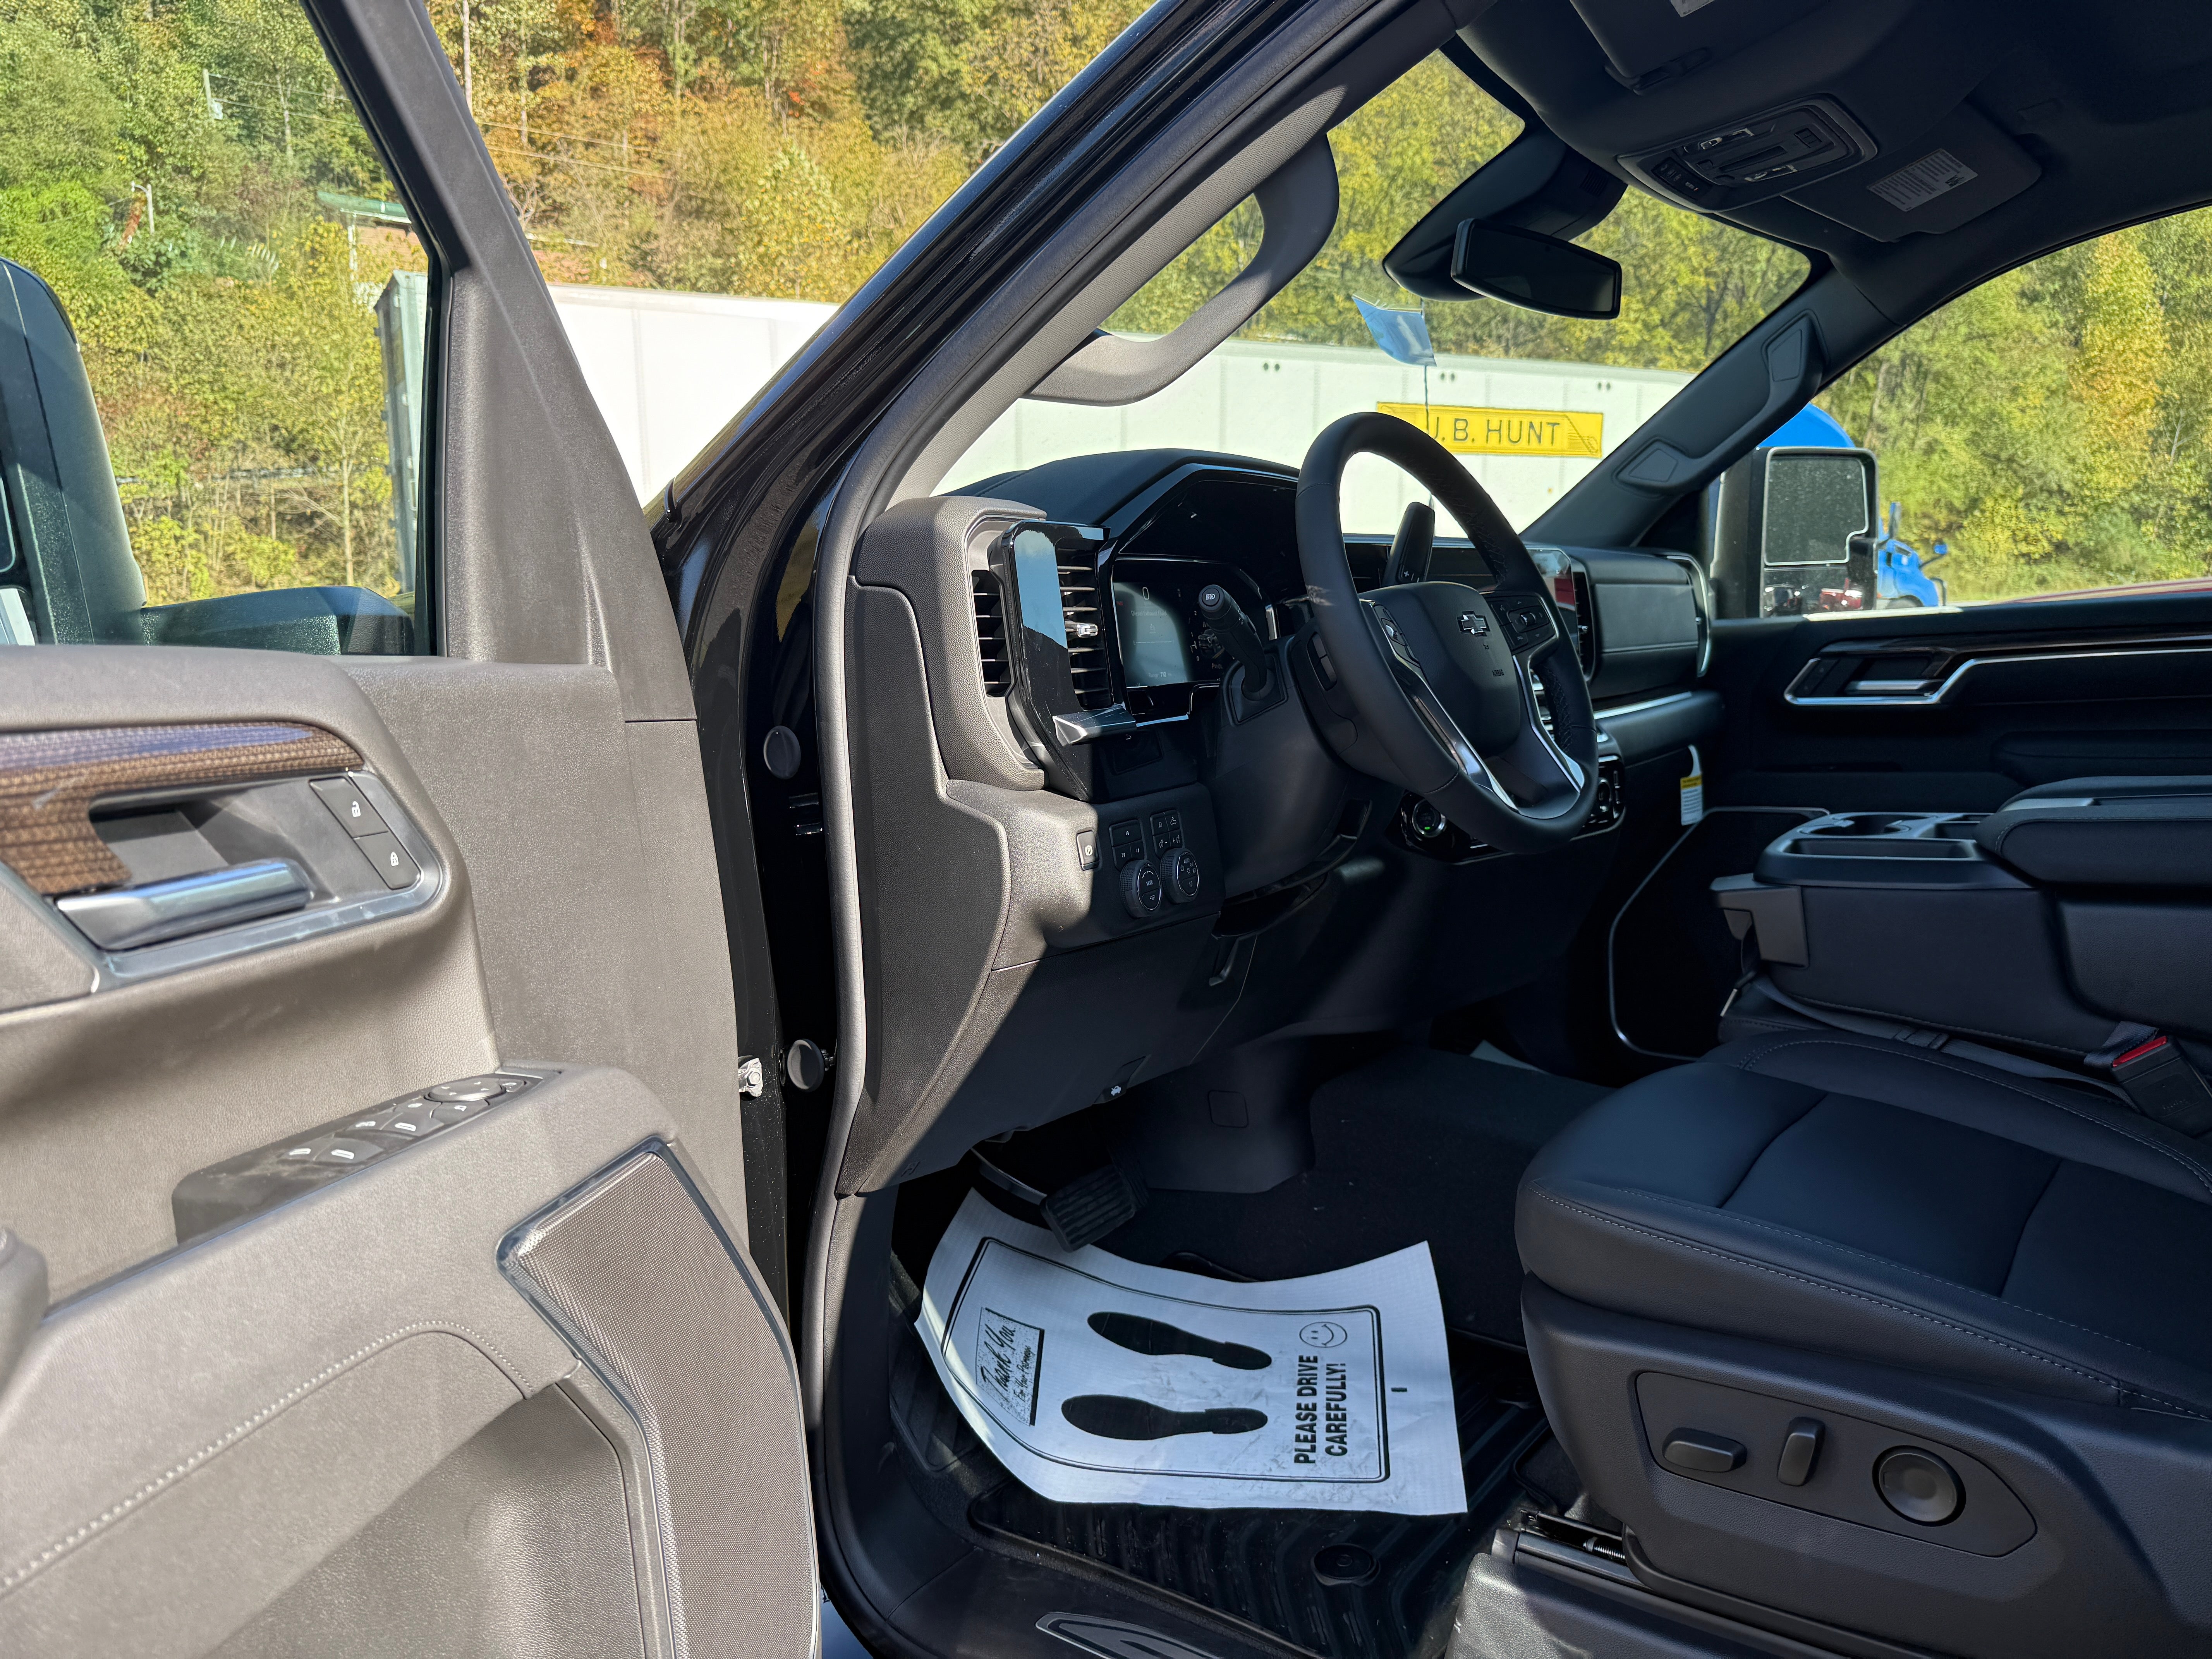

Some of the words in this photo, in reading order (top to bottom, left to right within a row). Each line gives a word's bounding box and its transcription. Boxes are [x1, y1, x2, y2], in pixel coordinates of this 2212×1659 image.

[1486, 419, 1560, 446] HUNT
[980, 1341, 1012, 1403] Thank
[1297, 1355, 1318, 1397] DRIVE
[1294, 1402, 1317, 1464] PLEASE
[1324, 1363, 1348, 1456] CAREFULLY!
